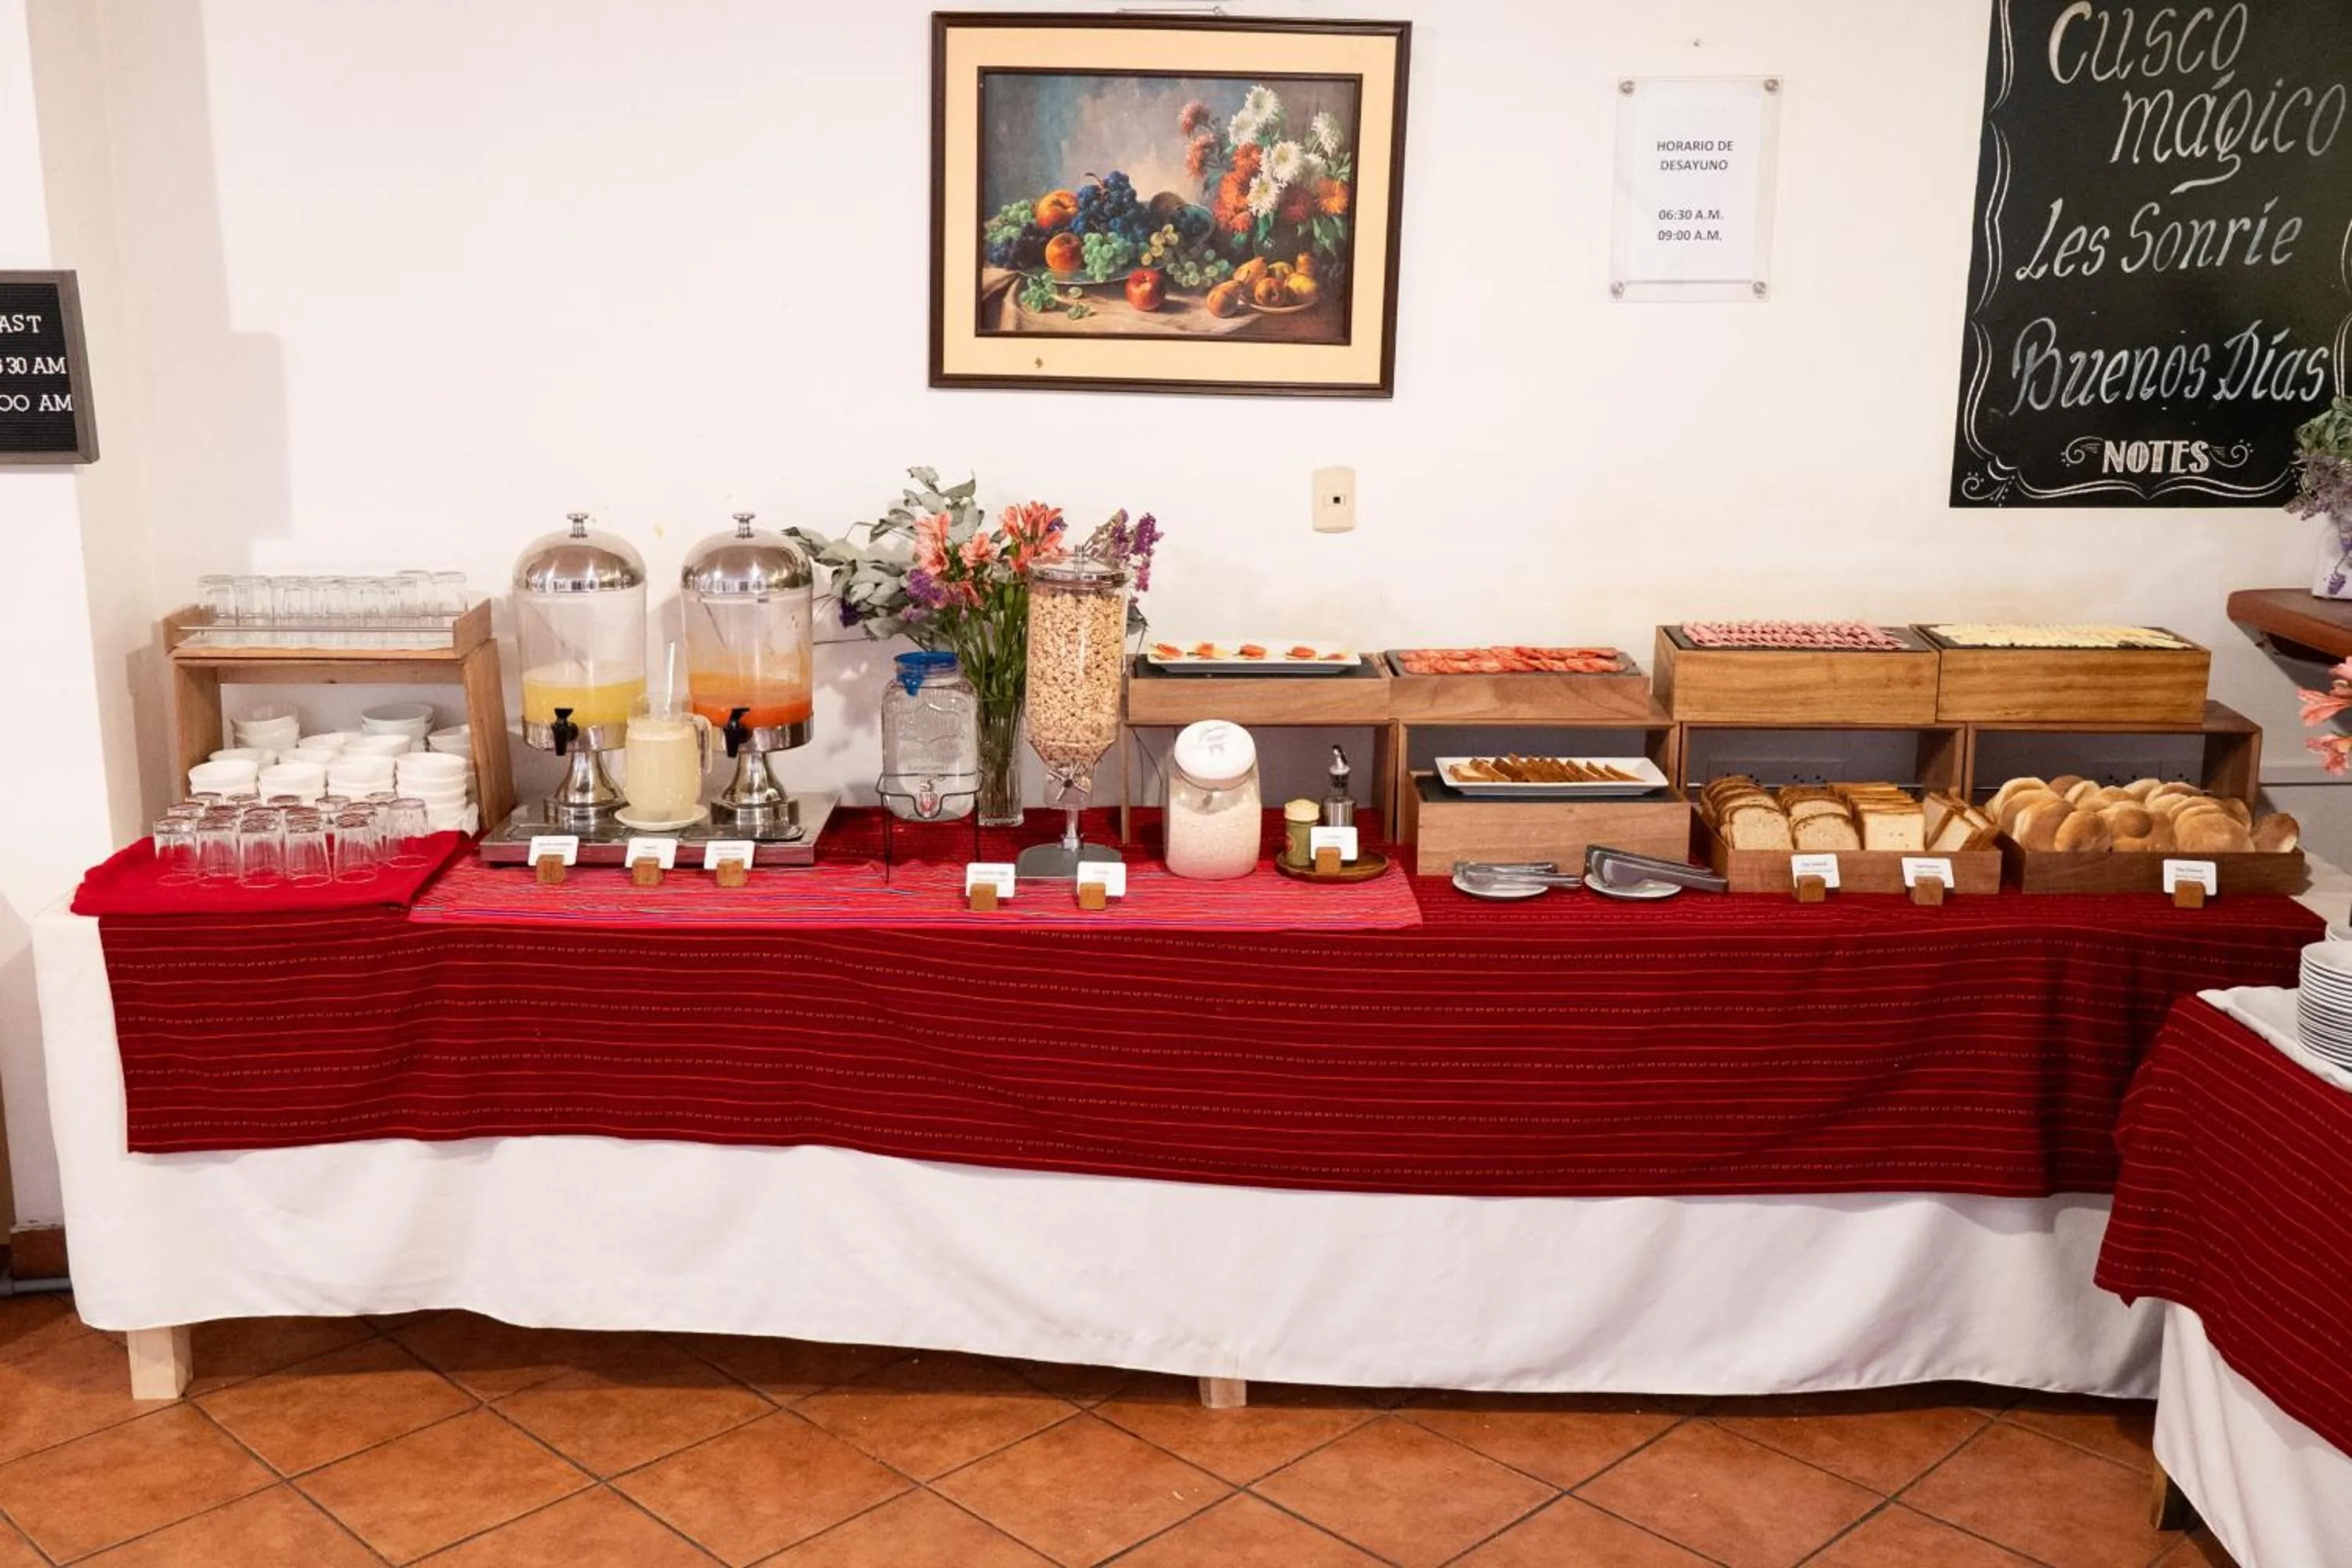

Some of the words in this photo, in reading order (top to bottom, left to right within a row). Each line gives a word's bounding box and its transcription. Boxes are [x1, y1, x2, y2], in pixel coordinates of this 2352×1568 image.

[1656, 140, 1715, 151] HORARIO
[1718, 140, 1735, 151] DE
[1660, 159, 1729, 170] DESAYUNO
[1658, 209, 1693, 220] 06:30
[1694, 209, 1724, 220] A.M.
[1657, 230, 1691, 241] 09:00
[1693, 230, 1723, 241] A.M.
[2014, 197, 2111, 282] Les
[32, 357, 67, 375] AM
[2008, 317, 2212, 416] Buenos
[2212, 318, 2330, 401] Días
[38, 394, 74, 412] AM
[2101, 440, 2211, 474] NOTES
